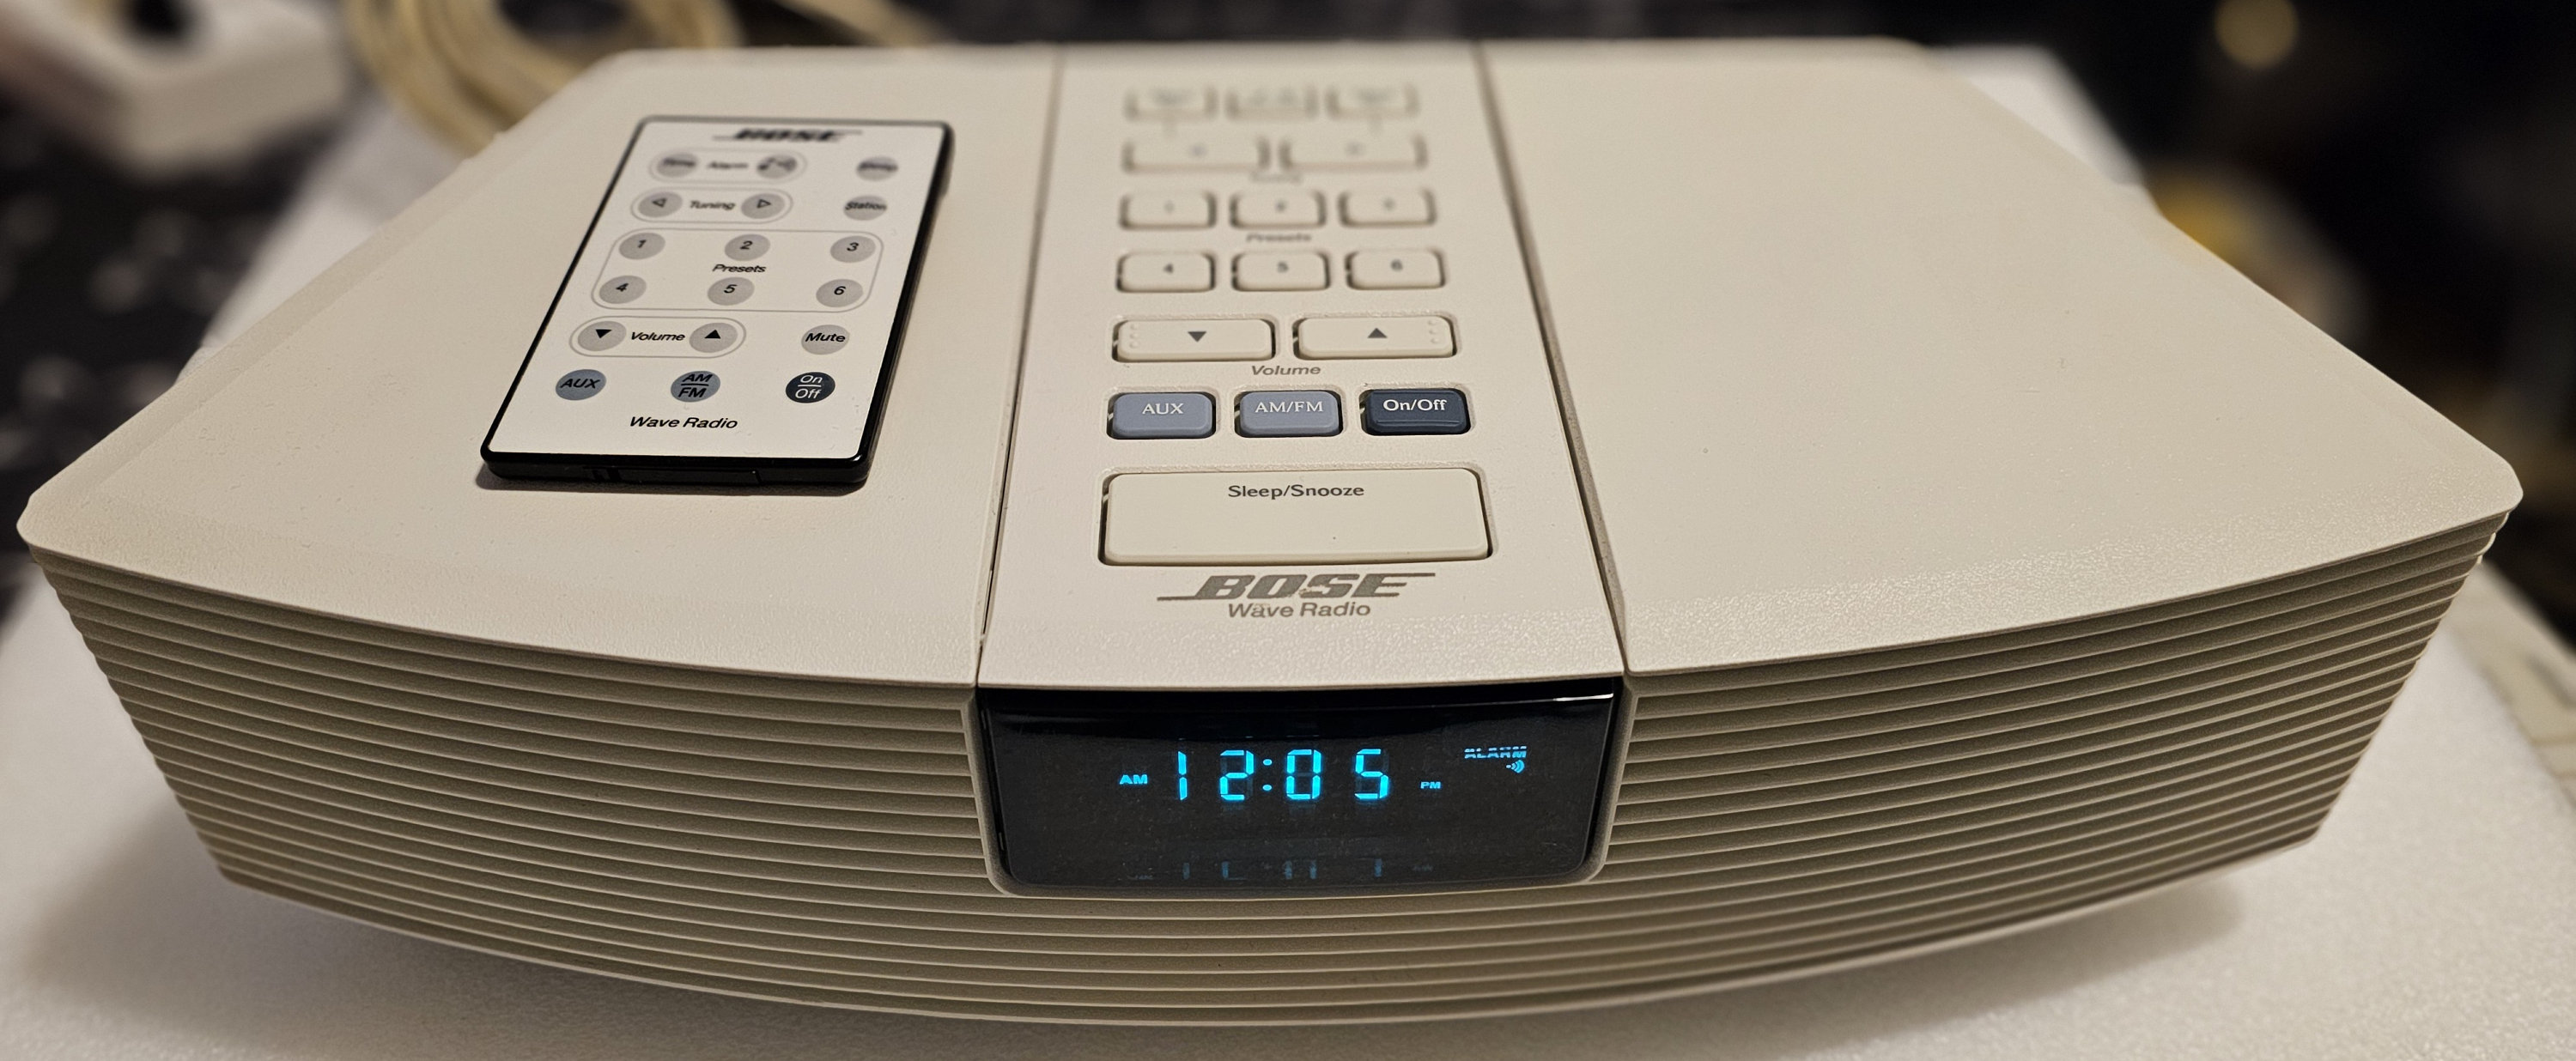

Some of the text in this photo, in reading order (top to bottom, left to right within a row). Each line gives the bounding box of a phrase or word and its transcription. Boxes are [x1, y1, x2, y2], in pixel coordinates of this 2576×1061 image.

[690, 200, 736, 211] Tuning
[845, 201, 887, 211] Station
[637, 239, 647, 249] 1
[739, 240, 753, 250] 2
[846, 241, 860, 252] 3
[712, 264, 767, 273] Presets
[1163, 263, 1175, 274] 4
[616, 282, 629, 293] 4
[723, 283, 738, 294] 5
[833, 285, 847, 295] 6
[631, 330, 686, 342] Volume
[805, 332, 846, 343] Mute
[1251, 365, 1321, 376] Volume
[560, 378, 601, 389] AUX
[681, 373, 714, 383] AM
[799, 375, 823, 385] On
[677, 388, 708, 398] FM
[794, 388, 822, 399] Off
[1142, 403, 1184, 415] AUX
[1255, 401, 1324, 413] AM/FM
[1382, 398, 1448, 411] On/Off
[629, 416, 738, 429] Wave Radio
[1228, 483, 1365, 500] Sleep/Snooze
[1157, 573, 1436, 601] BOSE
[1229, 601, 1371, 618] Wave Radio
[1464, 745, 1528, 759] ALARM
[1119, 773, 1149, 785] AM
[1420, 781, 1442, 790] PM
